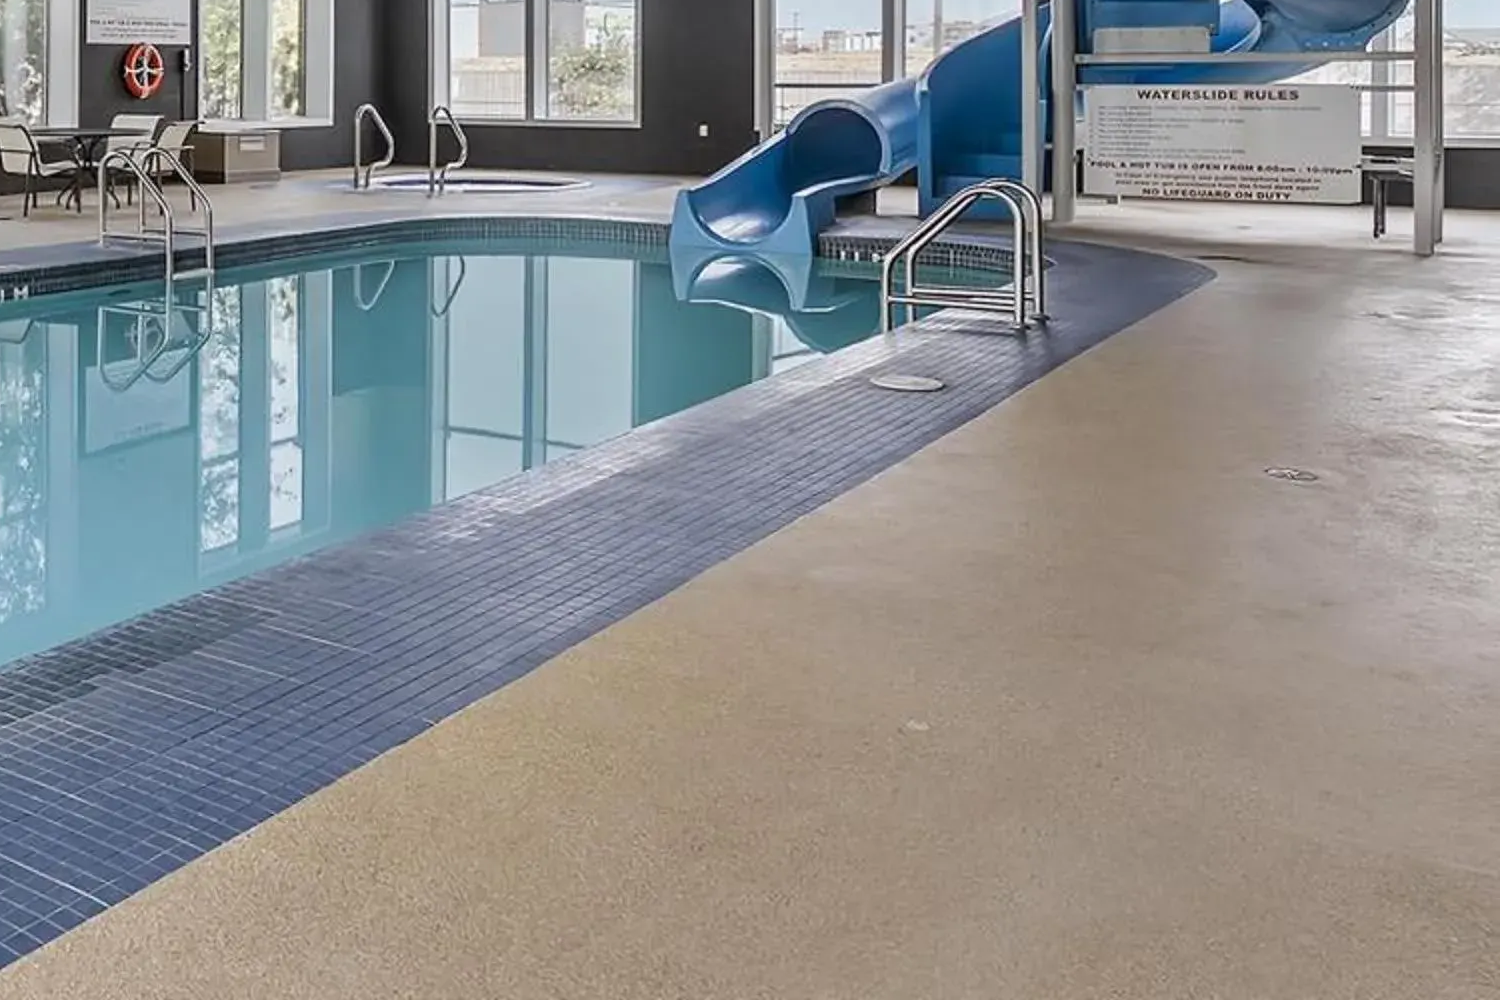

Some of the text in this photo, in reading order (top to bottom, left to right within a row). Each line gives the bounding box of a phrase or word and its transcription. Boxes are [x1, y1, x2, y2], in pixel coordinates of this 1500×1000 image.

[1137, 88, 1300, 101] WATERSLIDE RULES
[1130, 161, 1151, 169] HOT
[1155, 161, 1175, 170] TUB
[1178, 162, 1188, 170] IS
[1191, 162, 1221, 171] OPEN
[1223, 163, 1254, 172] FROM
[1142, 187, 1291, 200] NO LIFEGUARD ON DUTY
